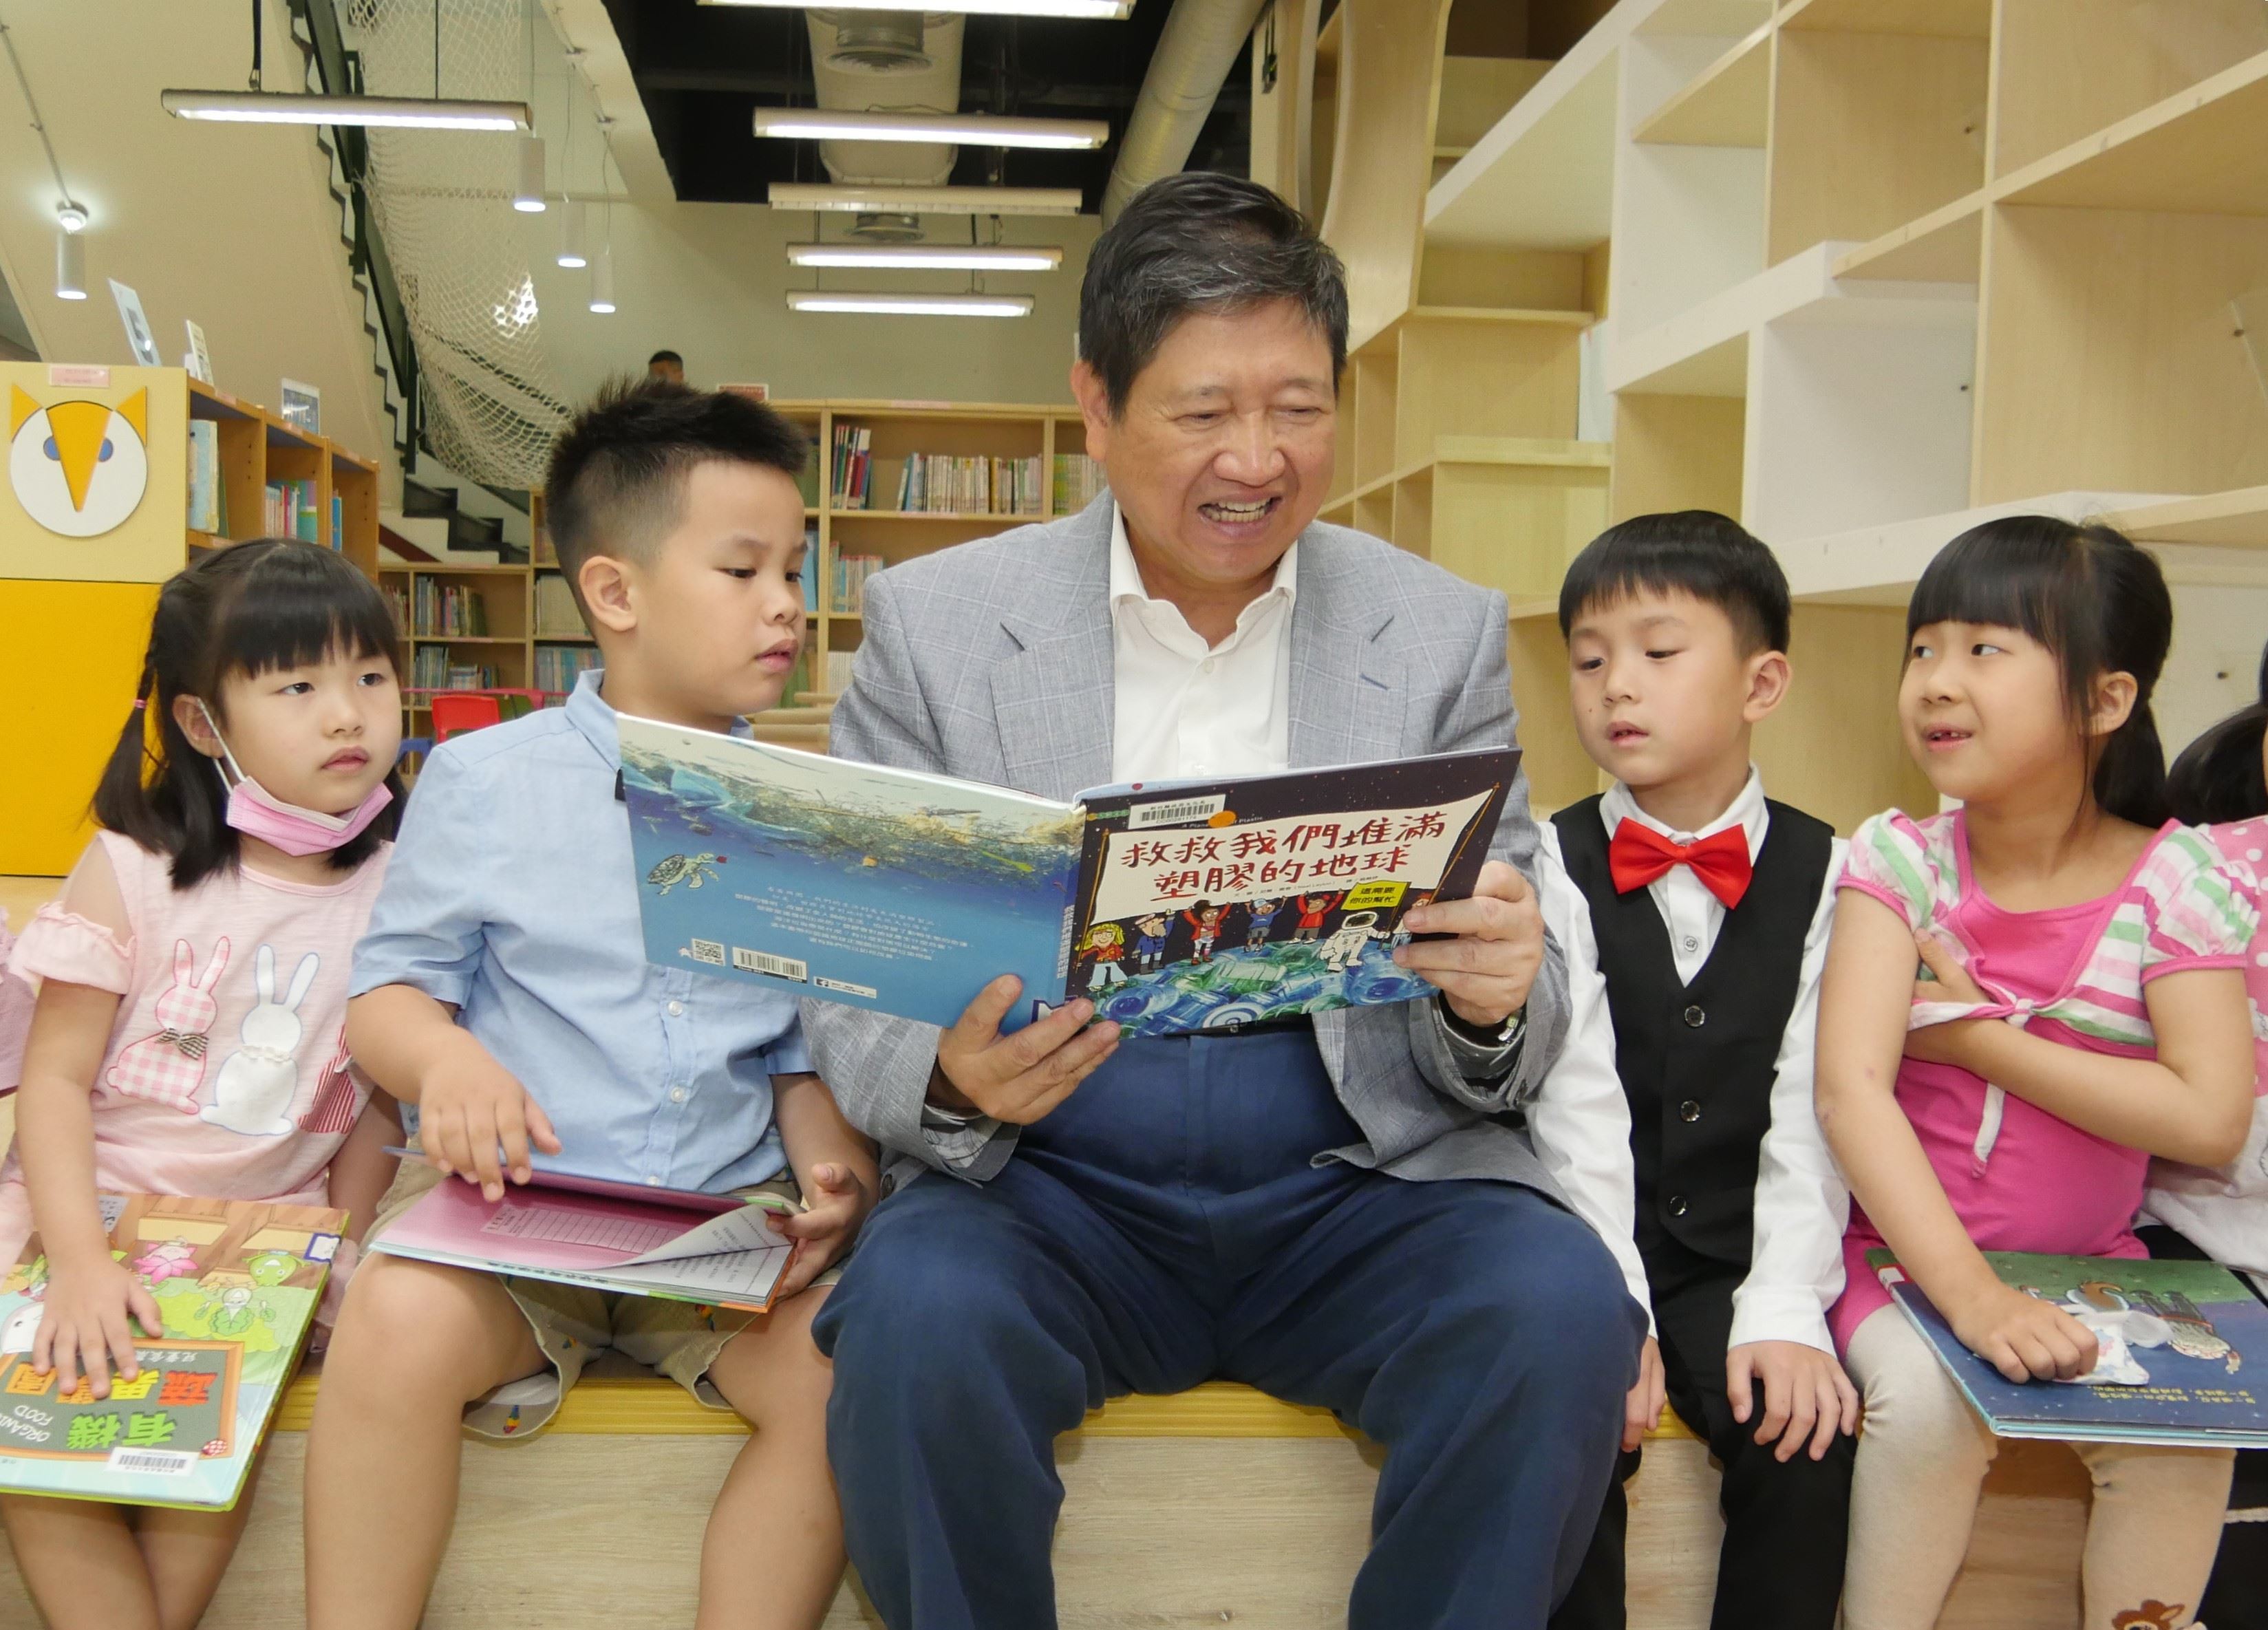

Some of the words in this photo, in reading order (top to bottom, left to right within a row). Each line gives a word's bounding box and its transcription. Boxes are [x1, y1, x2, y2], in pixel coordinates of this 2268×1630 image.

[1122, 814, 1444, 867] 救救我們堆滿
[1150, 845, 1410, 901] 塑膠的地球
[0, 1413, 51, 1443] ORGANI
[14, 1404, 54, 1426] FOOD
[65, 1410, 178, 1450] 有機
